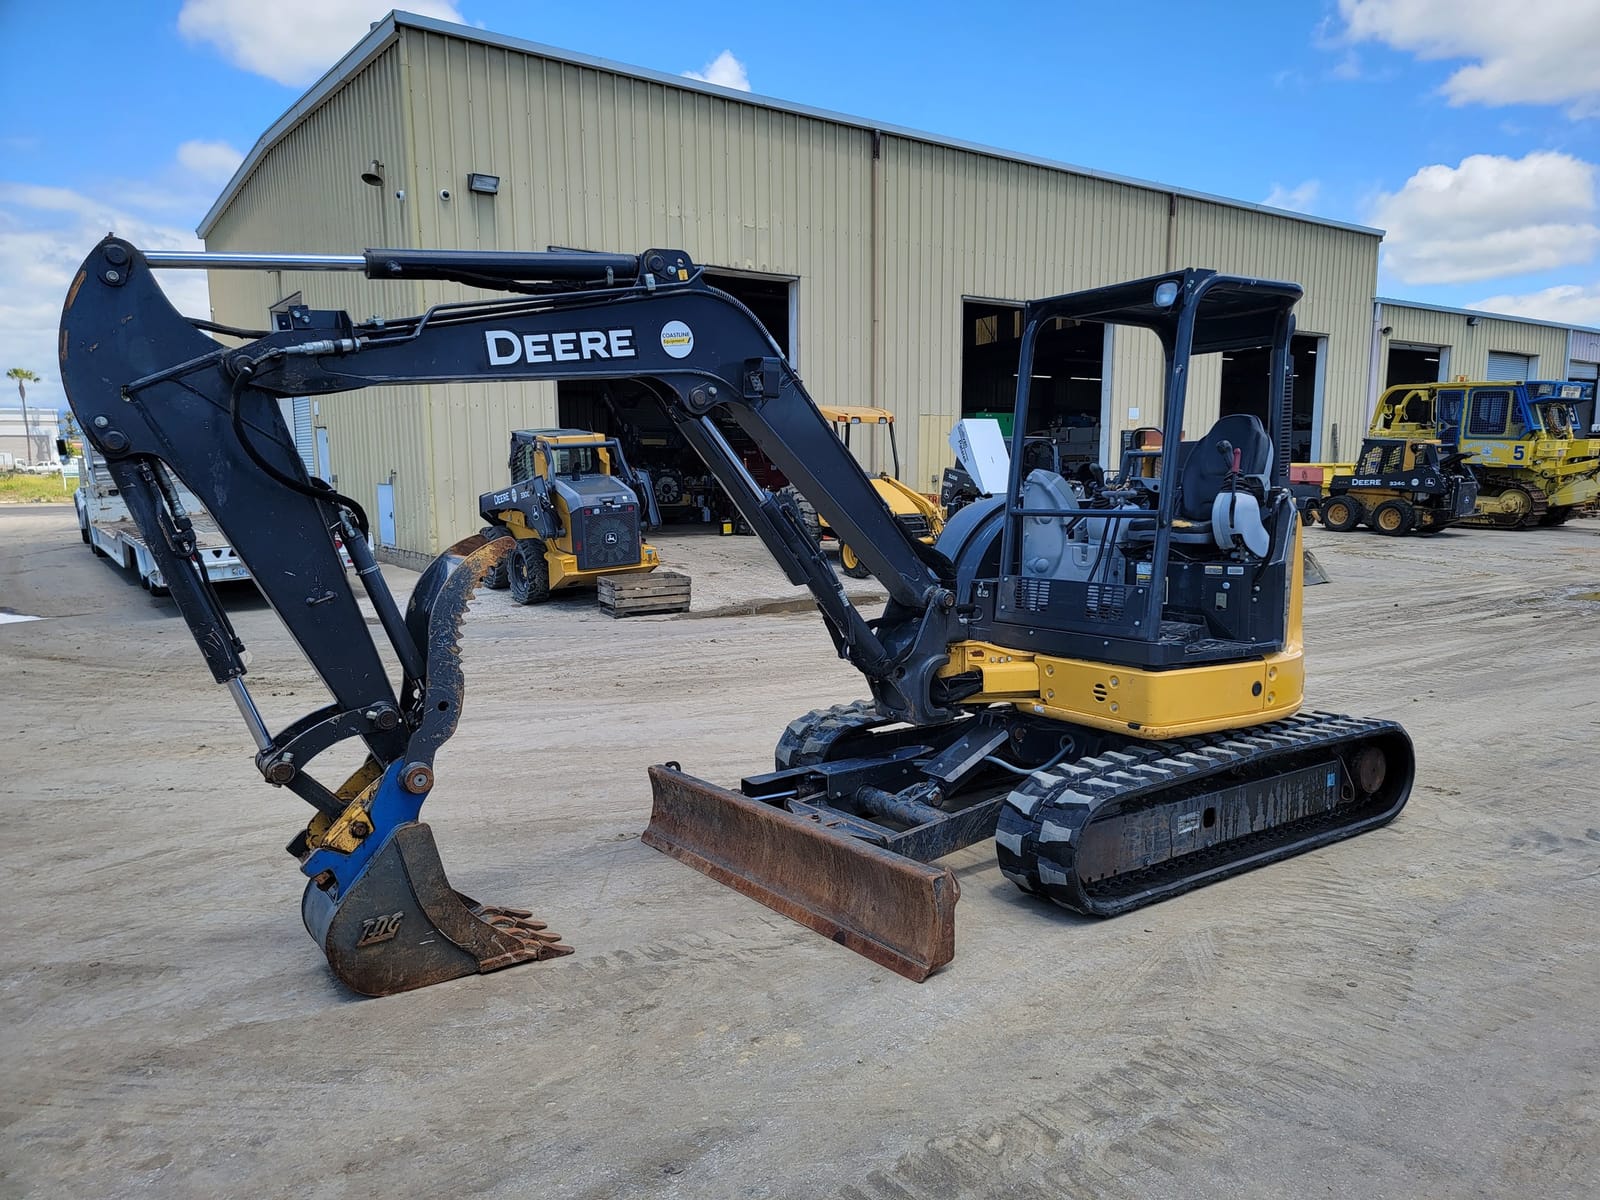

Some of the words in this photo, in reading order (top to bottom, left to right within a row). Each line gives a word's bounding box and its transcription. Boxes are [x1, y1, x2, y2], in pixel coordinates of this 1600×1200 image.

[662, 331, 690, 339] COASTLINE
[485, 328, 635, 366] DEERE
[1513, 445, 1525, 461] 5
[1351, 478, 1382, 486] DEERE
[493, 491, 511, 505] DEERE
